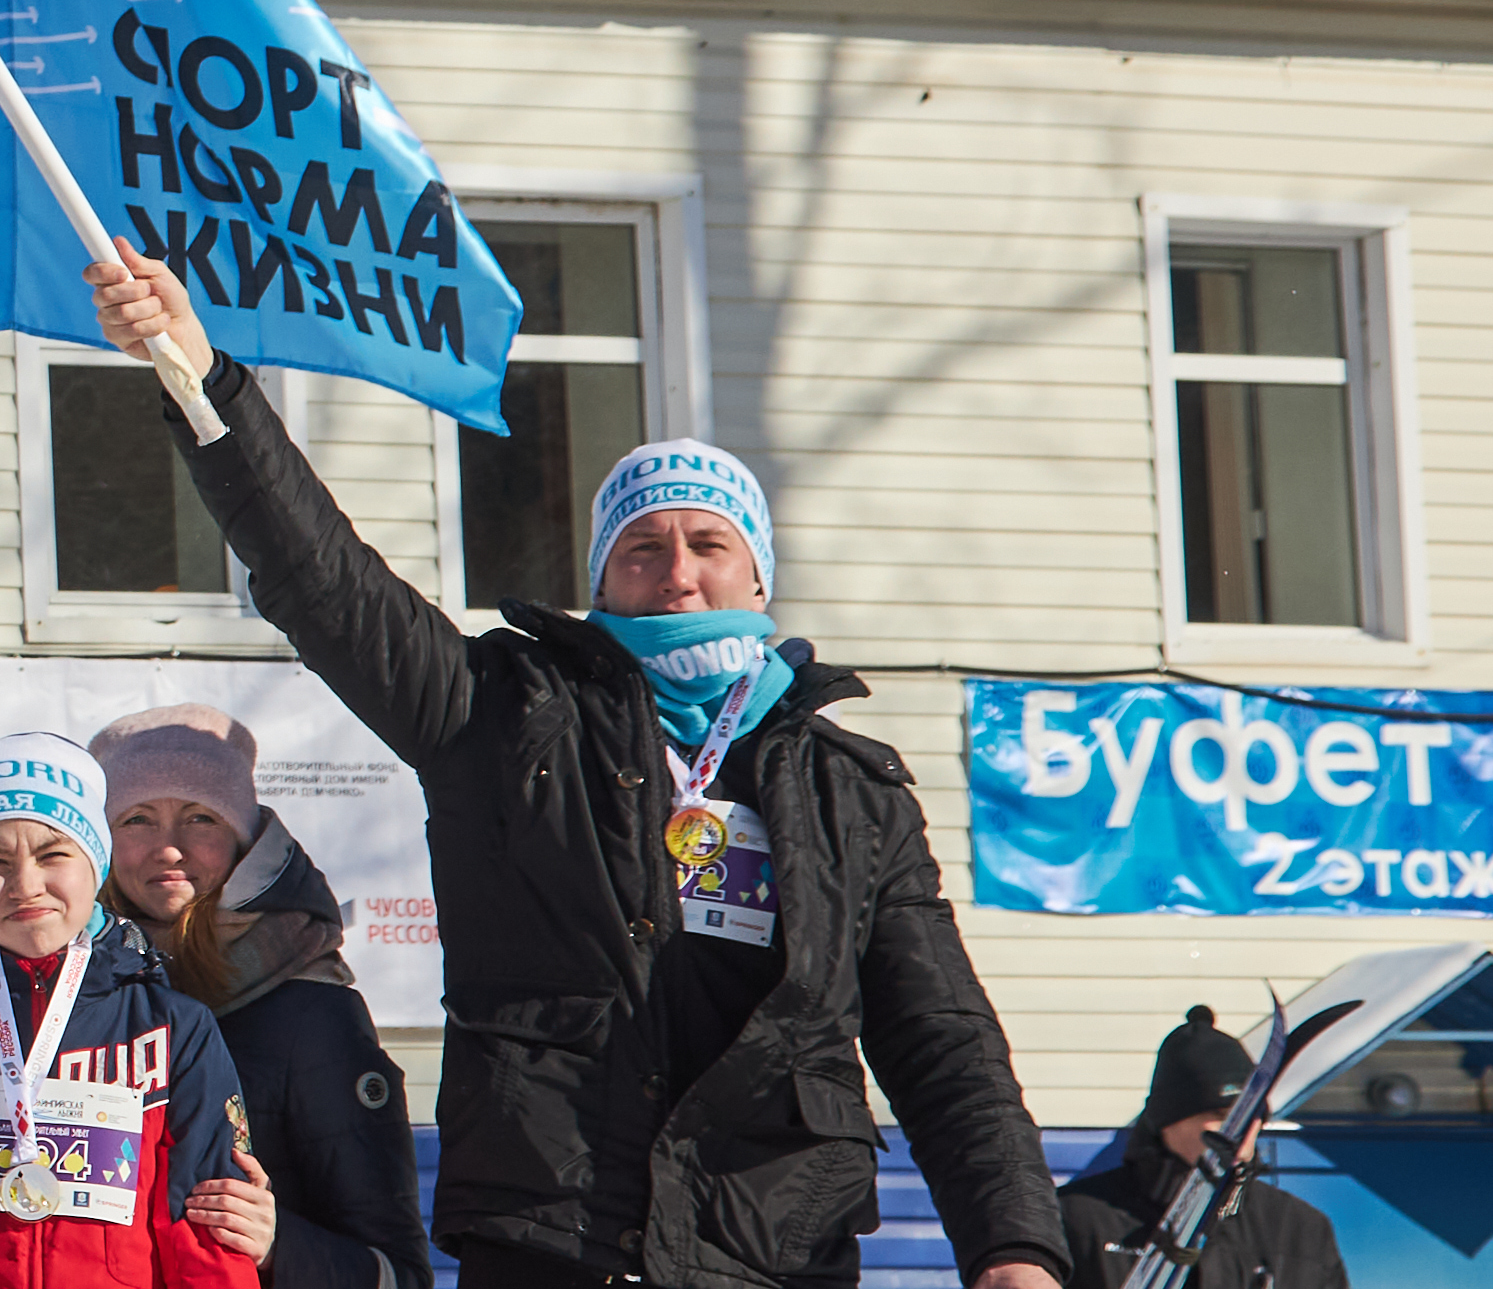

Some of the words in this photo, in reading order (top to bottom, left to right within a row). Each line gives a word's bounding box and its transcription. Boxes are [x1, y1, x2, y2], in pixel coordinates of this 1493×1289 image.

[113, 7, 370, 151] СОРТ
[114, 96, 458, 269] НОРМА
[123, 203, 467, 366] ЖИЗНИ
[1021, 690, 1452, 831] Буфет
[1253, 831, 1304, 897] 2
